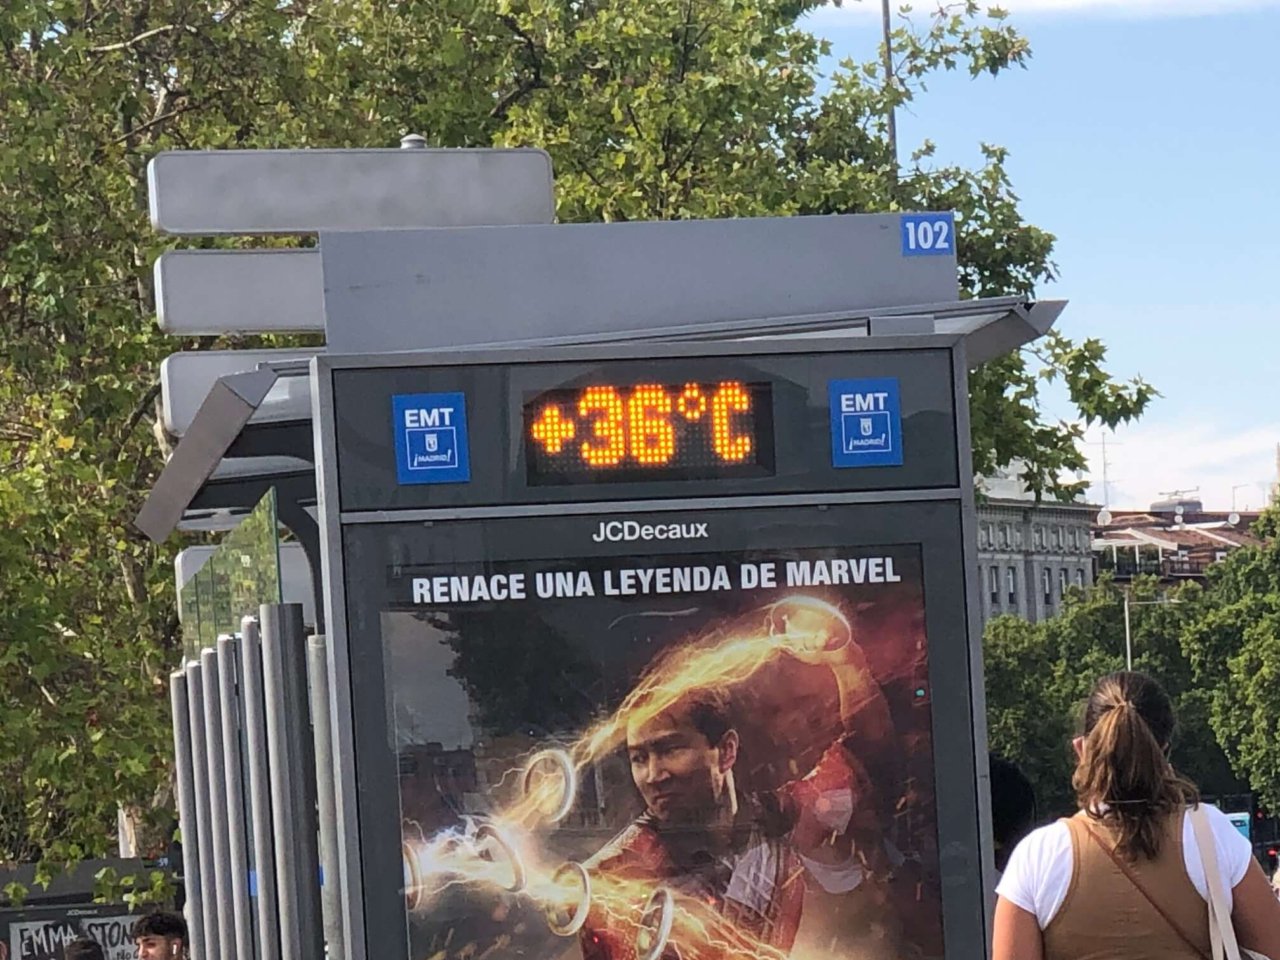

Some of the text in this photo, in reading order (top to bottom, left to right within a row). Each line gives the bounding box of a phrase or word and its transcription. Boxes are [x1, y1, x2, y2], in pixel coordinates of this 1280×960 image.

[905, 221, 949, 249] 102
[841, 392, 888, 411] EMT
[405, 408, 454, 427] EMT
[592, 521, 708, 542] JCDecaux
[412, 557, 901, 603] RENACE UNA LEYENDA DE MARVEL
[19, 921, 140, 957] EMMA STON
